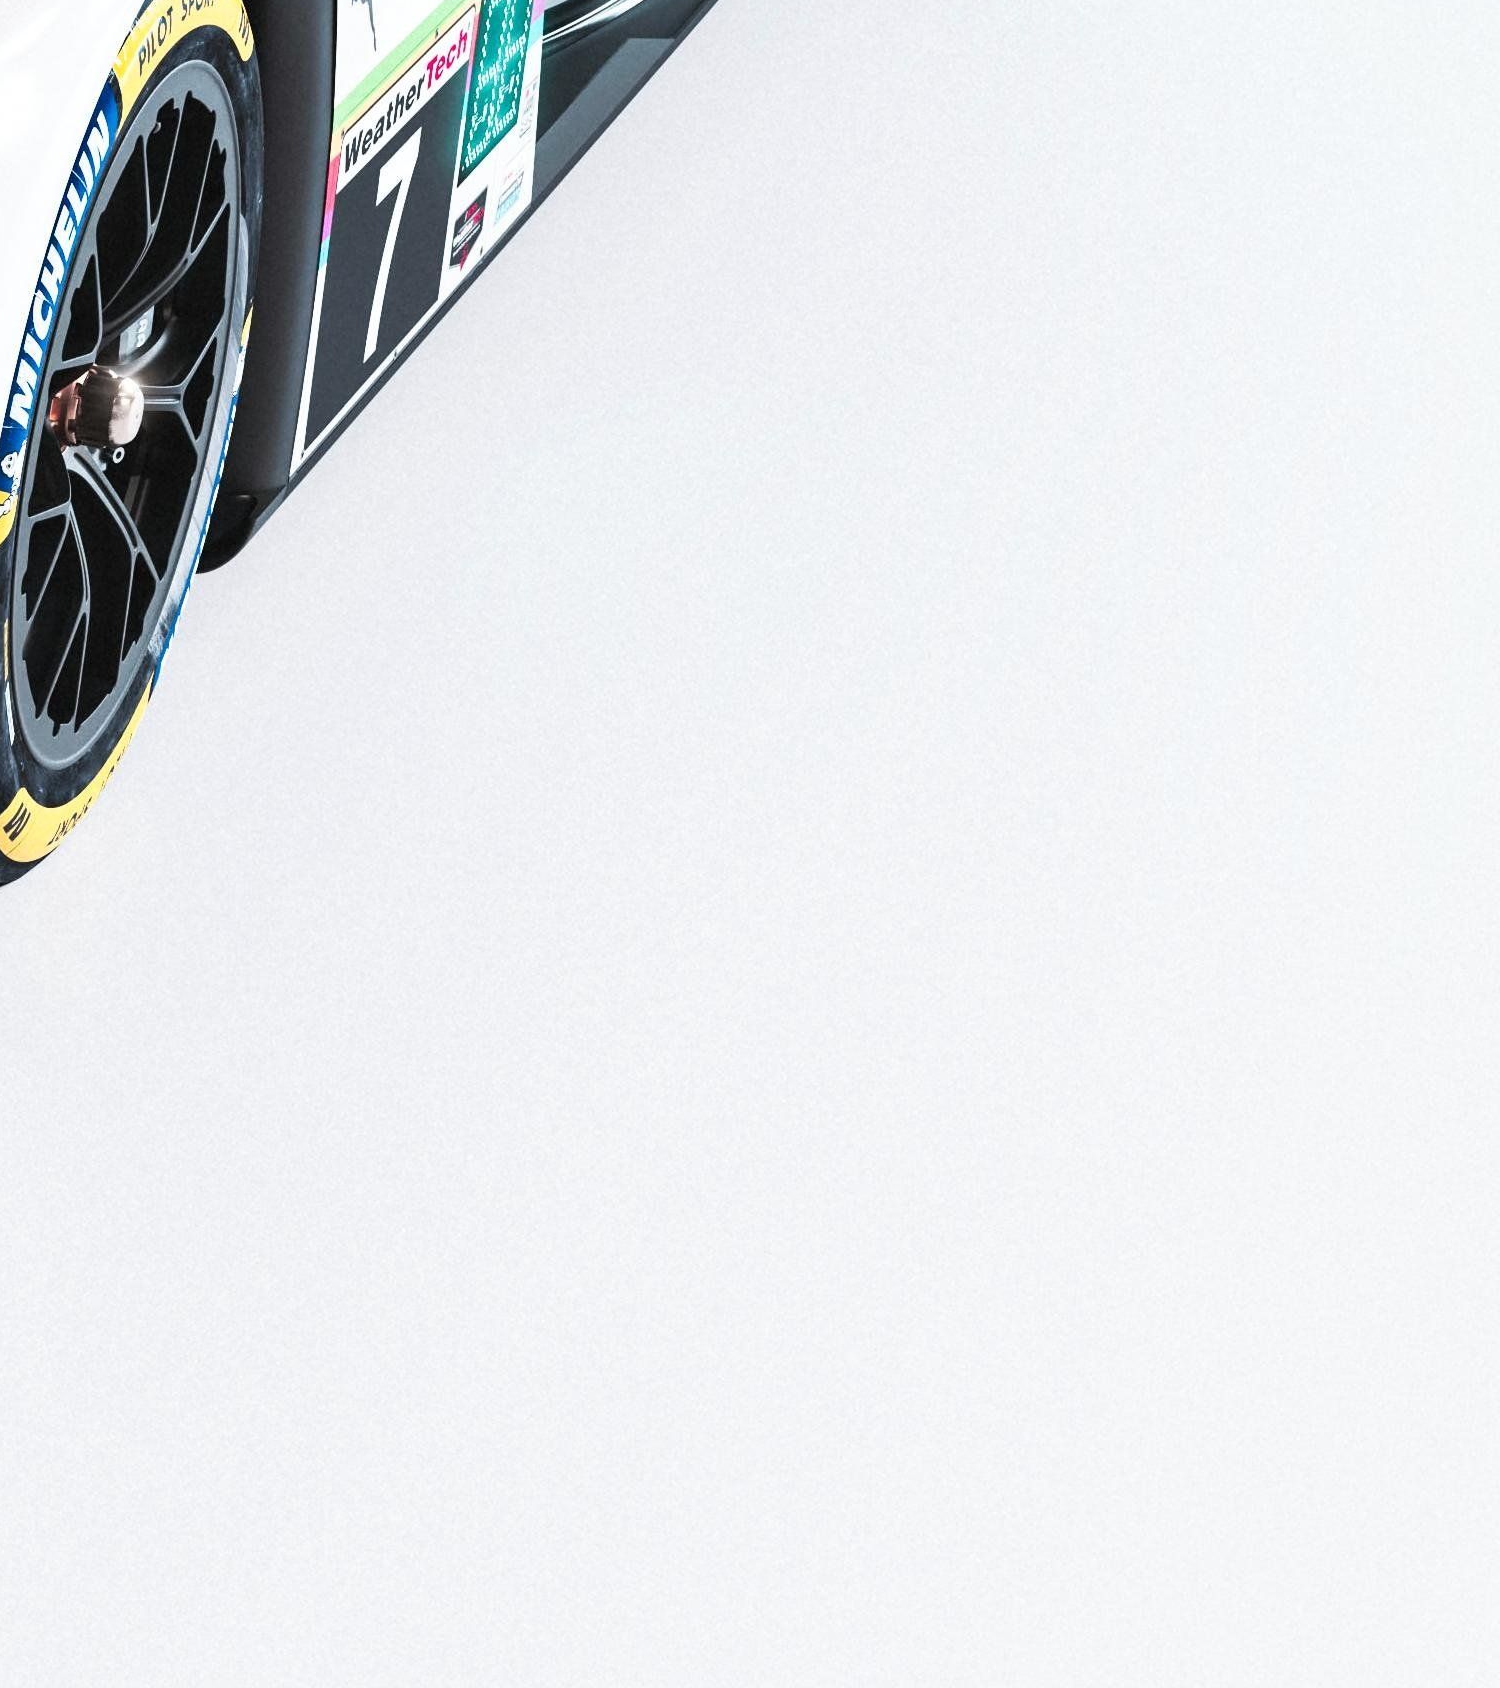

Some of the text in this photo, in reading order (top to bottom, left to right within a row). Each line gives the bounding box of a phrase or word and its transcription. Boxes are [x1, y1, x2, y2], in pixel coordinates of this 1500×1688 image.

[138, 5, 174, 78] PILOT
[343, 30, 470, 175] WeatherTech
[8, 109, 109, 429] MICHELIN
[362, 126, 423, 365] 7
